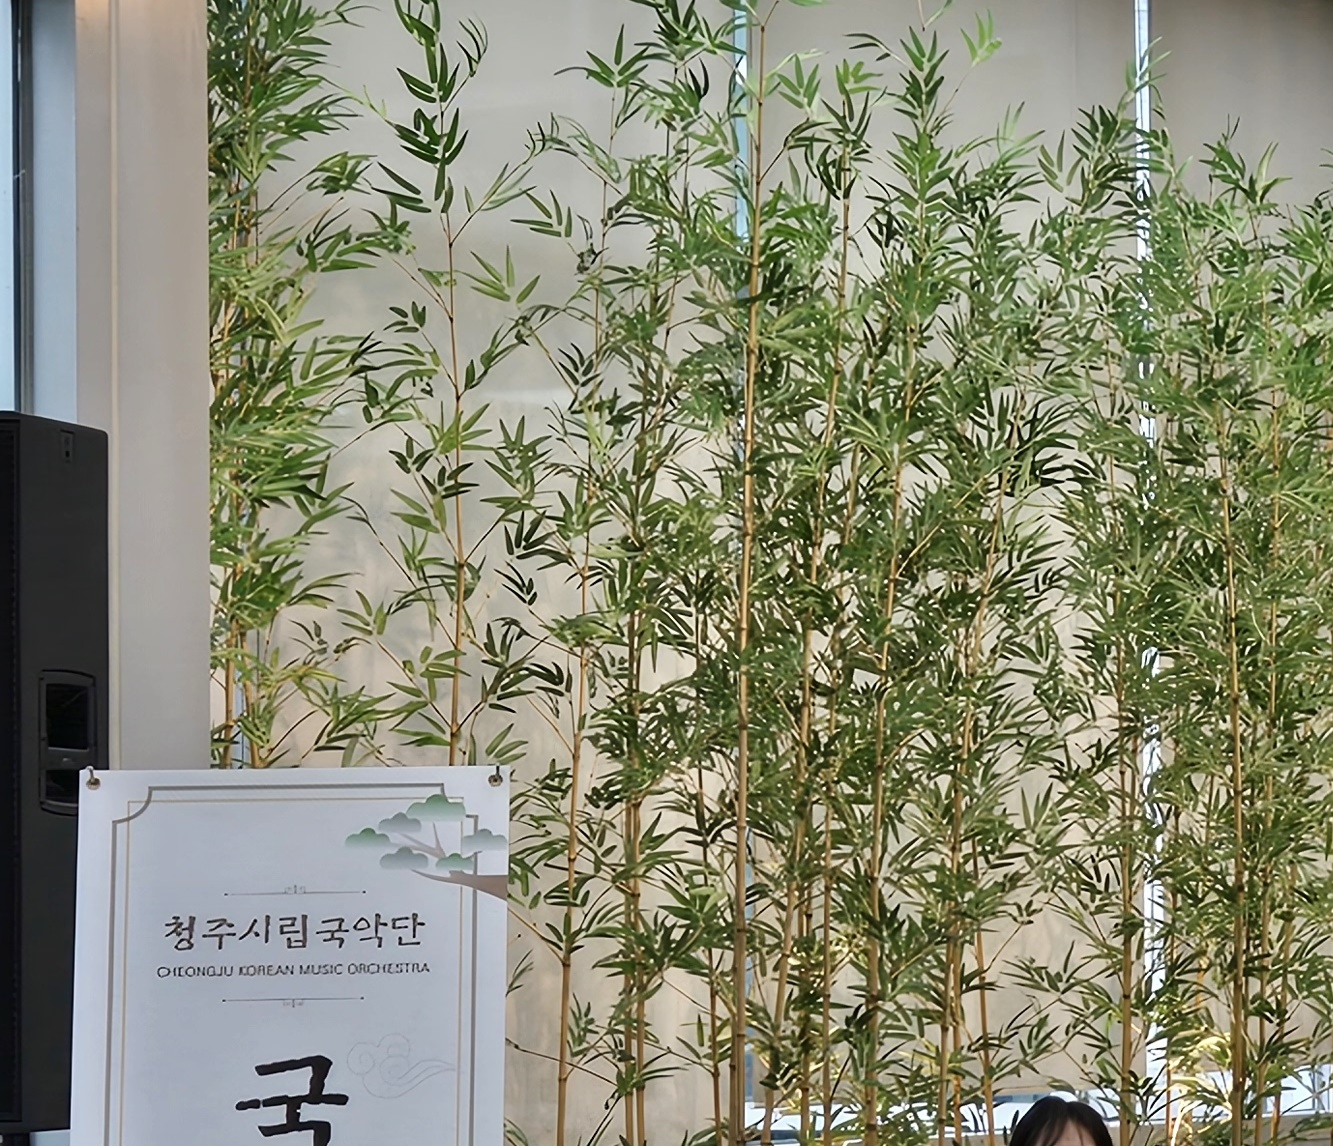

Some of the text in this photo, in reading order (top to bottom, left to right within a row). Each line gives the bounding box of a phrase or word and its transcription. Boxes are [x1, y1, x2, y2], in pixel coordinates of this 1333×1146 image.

[164, 912, 426, 951] 청주시립국악단
[157, 962, 431, 979] CHEONGJU KOREAN MUSIC ORCHESTRA
